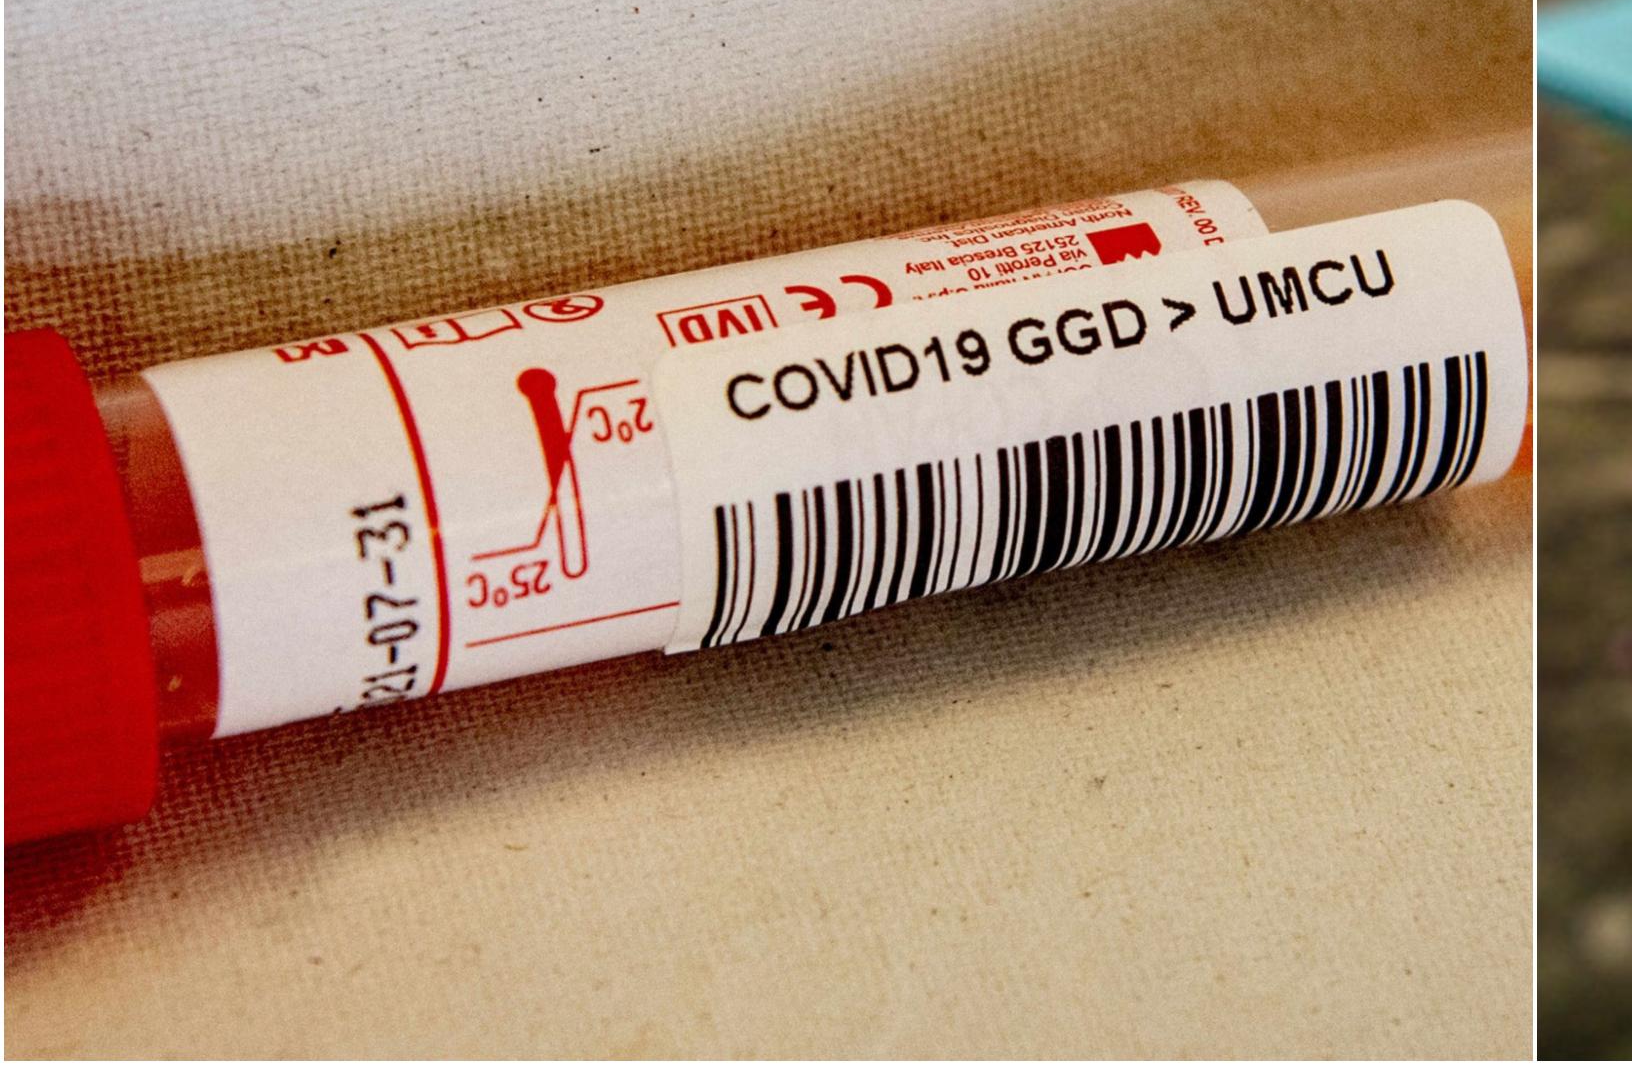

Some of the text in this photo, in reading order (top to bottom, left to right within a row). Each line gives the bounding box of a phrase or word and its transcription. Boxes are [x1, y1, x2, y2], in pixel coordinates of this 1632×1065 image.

[991, 217, 1077, 239] American
[1080, 208, 1133, 224] North
[905, 234, 1080, 275] 25125 Brescia Italy
[995, 253, 1057, 277] Perotti
[1058, 248, 1088, 263] via
[967, 266, 991, 282] 10
[677, 303, 764, 344] IVD
[725, 246, 1396, 422] COVID19 GGD > UMCU
[466, 560, 552, 610] 25°C
